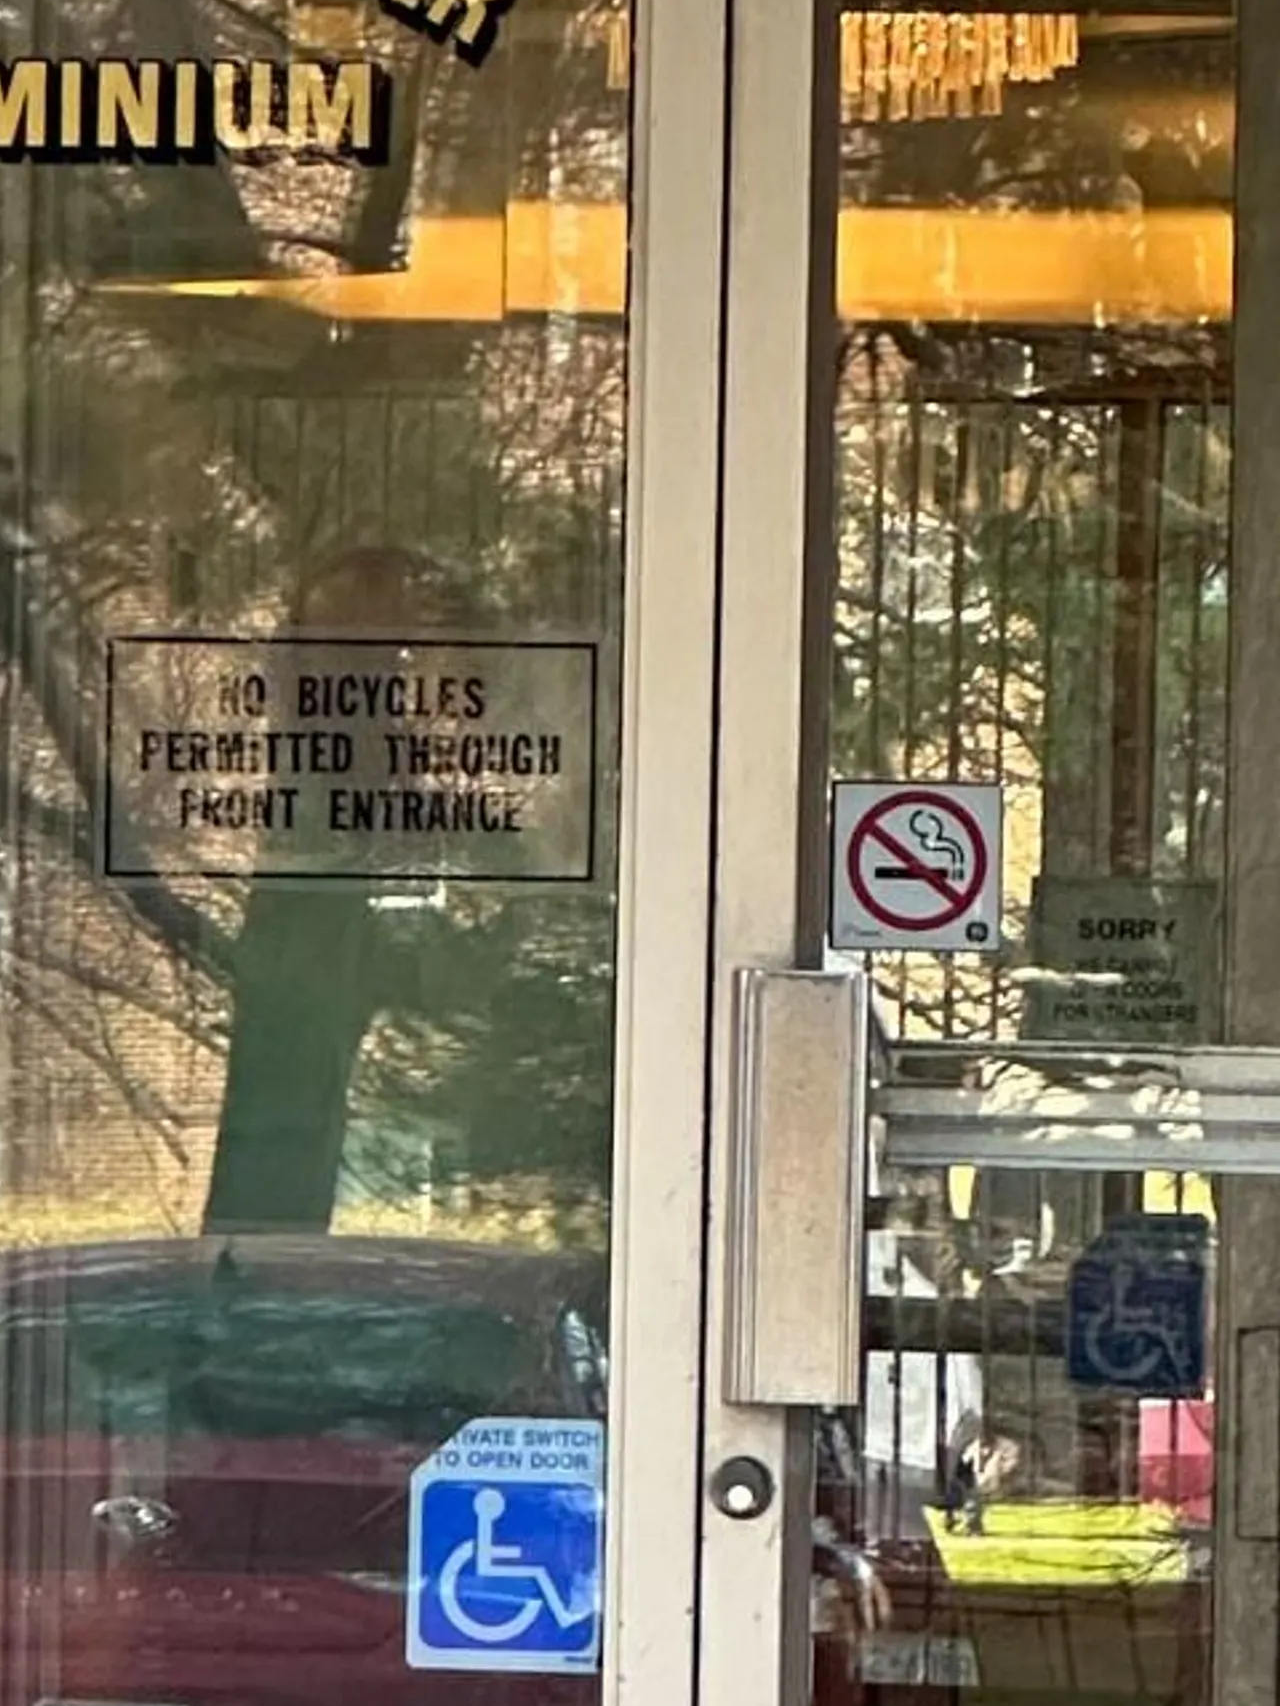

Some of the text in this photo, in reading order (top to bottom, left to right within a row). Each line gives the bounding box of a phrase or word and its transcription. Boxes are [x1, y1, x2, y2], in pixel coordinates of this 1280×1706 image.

[219, 674, 485, 719] NO BICYCLES
[139, 730, 562, 776] PERMITTED THROUGH
[179, 788, 523, 833] FRONT ENTRANCE
[467, 1450, 523, 1468] OPEN
[529, 1451, 589, 1470] DOOR
[522, 1429, 599, 1448] SWITCH
